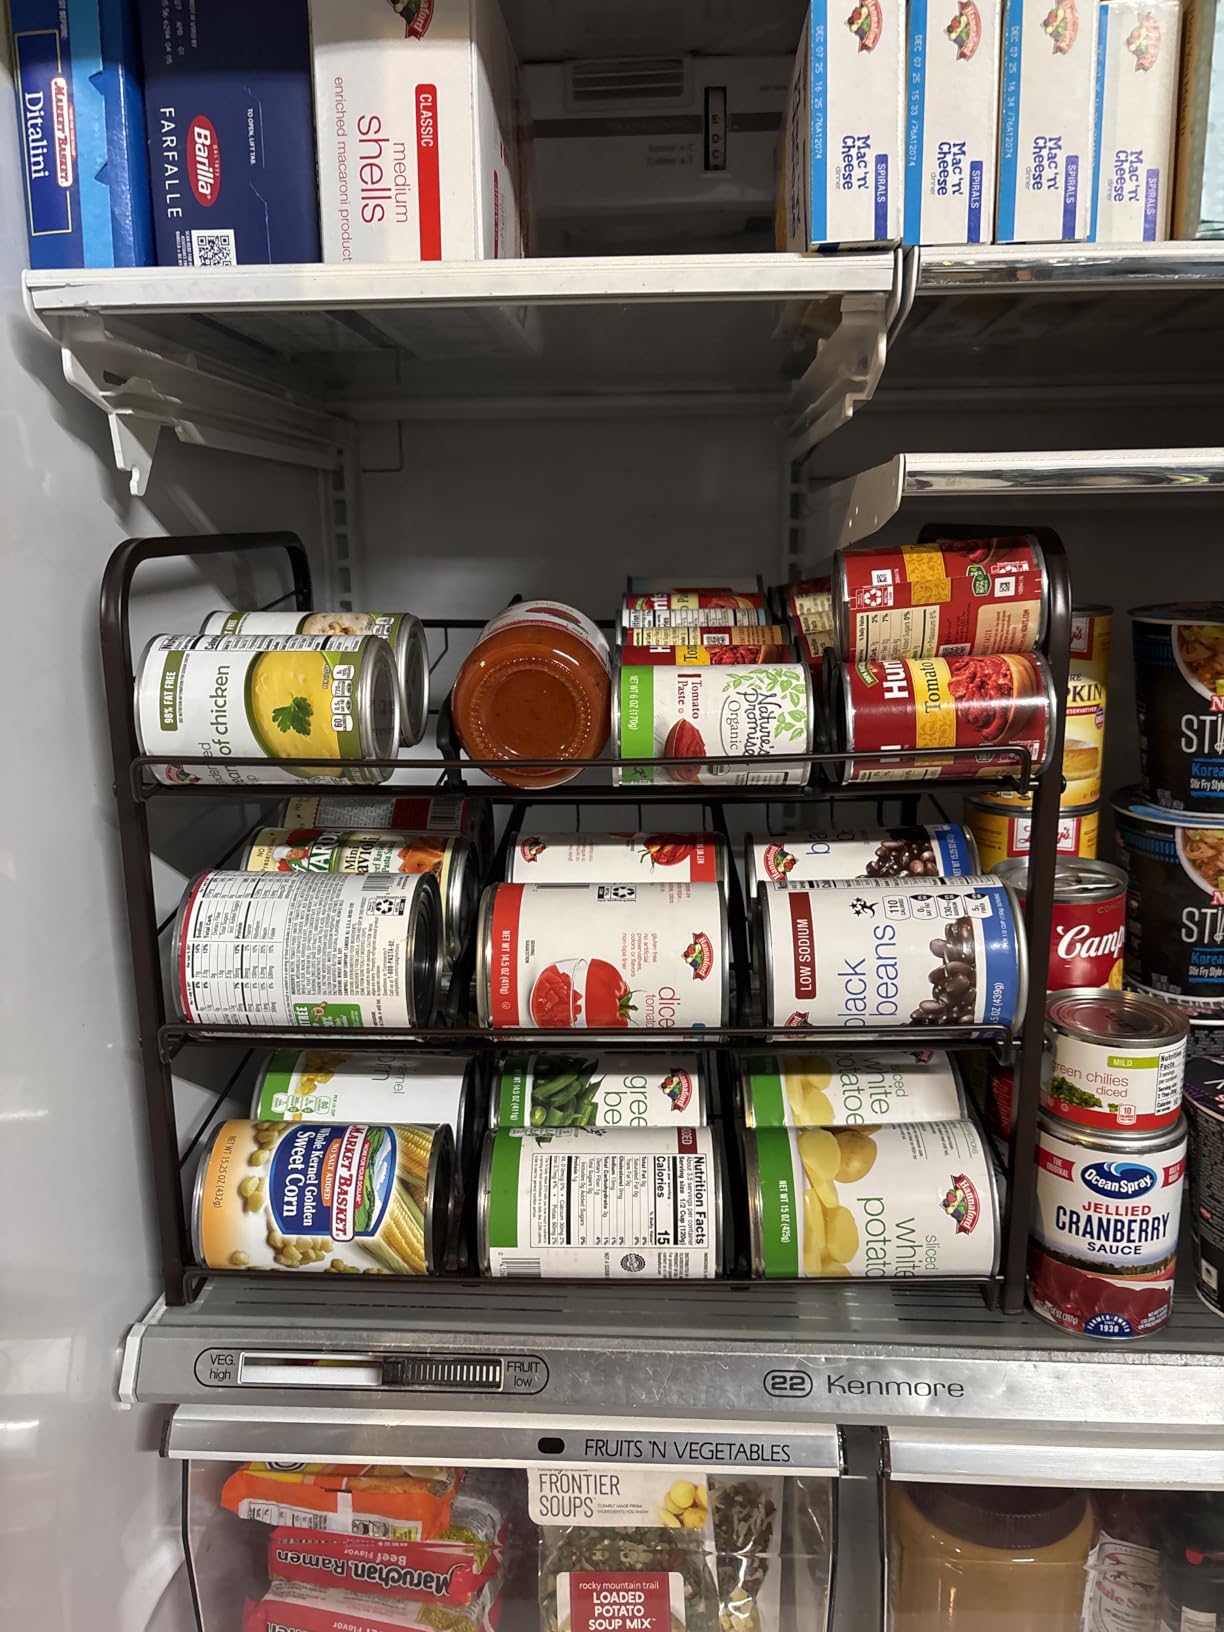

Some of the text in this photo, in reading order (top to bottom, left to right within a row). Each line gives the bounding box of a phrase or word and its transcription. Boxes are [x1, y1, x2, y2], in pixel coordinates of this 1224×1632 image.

[53, 80, 68, 134] MARKET
[418, 93, 434, 148] CLASSIC
[24, 91, 49, 180] Ditalini
[856, 135, 871, 170] Mac
[1048, 135, 1062, 170] Mac
[160, 106, 183, 219] FARFALLE
[193, 126, 212, 196] Barilla
[334, 77, 353, 262] enriched macaroni product
[357, 115, 393, 224] shells
[842, 135, 856, 190] Cheese
[937, 142, 952, 196] Cheese
[952, 142, 967, 175] Mac
[1032, 136, 1047, 191] Cheese
[1129, 150, 1143, 182] Mac
[393, 142, 411, 223] medium
[877, 163, 886, 203] SPIRALS
[971, 170, 981, 209] SPIRALS
[1066, 165, 1077, 204] SPIRALS
[1114, 150, 1128, 202] Cheese
[1146, 178, 1157, 215] SPIRALS
[629, 675, 638, 684] NET
[629, 685, 638, 693] WT
[677, 680, 688, 706] Paste
[882, 660, 909, 699] Hun
[921, 661, 942, 713] Tomato
[163, 671, 177, 724] 98% FAT FREE
[210, 665, 231, 756] of chicken
[629, 700, 638, 708] OZ
[690, 680, 702, 720] Tomato
[334, 718, 343, 728] 60
[628, 709, 639, 730] (170g)
[726, 700, 741, 750] Organic
[1190, 778, 1211, 791] Stir Fry
[1192, 763, 1224, 777] Korea
[344, 846, 359, 869] Mini
[355, 837, 379, 872] avioli
[764, 844, 781, 880] Hannaford
[888, 899, 900, 914] 110
[651, 933, 659, 951] gluten
[697, 936, 713, 977] Hannaford
[796, 918, 813, 991] LOW SODIUM
[1191, 952, 1224, 966] Korea
[499, 929, 511, 995] NET WT 14.5 OZ (411g)
[869, 924, 899, 1016] beans
[1200, 966, 1209, 977] Fry
[657, 986, 681, 1029] dice
[991, 982, 1005, 1016] OZ (439g)
[1112, 1058, 1134, 1067] MILD
[1160, 1050, 1183, 1063] Nutrition
[1160, 1062, 1175, 1070] Facts
[836, 1052, 867, 1125] potatoe
[1086, 1071, 1129, 1088] chilies
[1095, 1085, 1129, 1098] diced
[510, 1102, 519, 1121] (411g)
[623, 1075, 650, 1127] gree
[1122, 1106, 1133, 1115] 10
[290, 1131, 315, 1170] Sweet
[678, 1156, 686, 1179] Serving
[213, 1135, 237, 1209] NET WT 15.25 OZ (432g)
[301, 1128, 332, 1226] Whole Kernel Golden
[322, 1143, 340, 1200] NO SALT ADDED
[334, 1125, 367, 1237] MARKET BASKET
[1084, 1168, 1152, 1194] Ocean Spray
[282, 1173, 306, 1217] Corn
[656, 1155, 670, 1246] Calories 15
[694, 1156, 707, 1245] Nutrition Facts
[778, 1180, 791, 1243] NET WT 15 OZ (425g)
[959, 1179, 979, 1230] Hannaford
[1082, 1201, 1152, 1217] JELLIED
[678, 1210, 686, 1223] Cup
[1055, 1205, 1170, 1244] CRANBERRY
[580, 1236, 586, 1245] 0%
[619, 1236, 624, 1245] 0%
[634, 1236, 639, 1245] 0%
[641, 1236, 647, 1245] 0%
[678, 1225, 687, 1246] (120g)
[856, 1197, 892, 1277] potato
[895, 1217, 924, 1276] white
[925, 1234, 941, 1271] sliced
[1087, 1241, 1142, 1255] SAUCE
[1100, 1324, 1119, 1333] 1930
[209, 1353, 236, 1366] VEG.
[209, 1367, 232, 1381] high
[506, 1360, 541, 1374] FRUIT
[513, 1375, 533, 1388] low
[770, 1375, 807, 1392] 22
[827, 1374, 965, 1398] Kenmore
[584, 1438, 791, 1463] FRUITS 'N VEGETABLES
[538, 1472, 621, 1496] FRONTIER
[538, 1495, 594, 1518] SOUPS
[275, 1549, 454, 1598] Maruchan Ramen
[343, 1547, 408, 1567] Beef Flavor
[579, 1581, 659, 1591] rocky mountain trail
[593, 1591, 645, 1604] LOADED
[588, 1618, 652, 1631] SOUP MIX
[594, 1605, 645, 1617] POTATO
